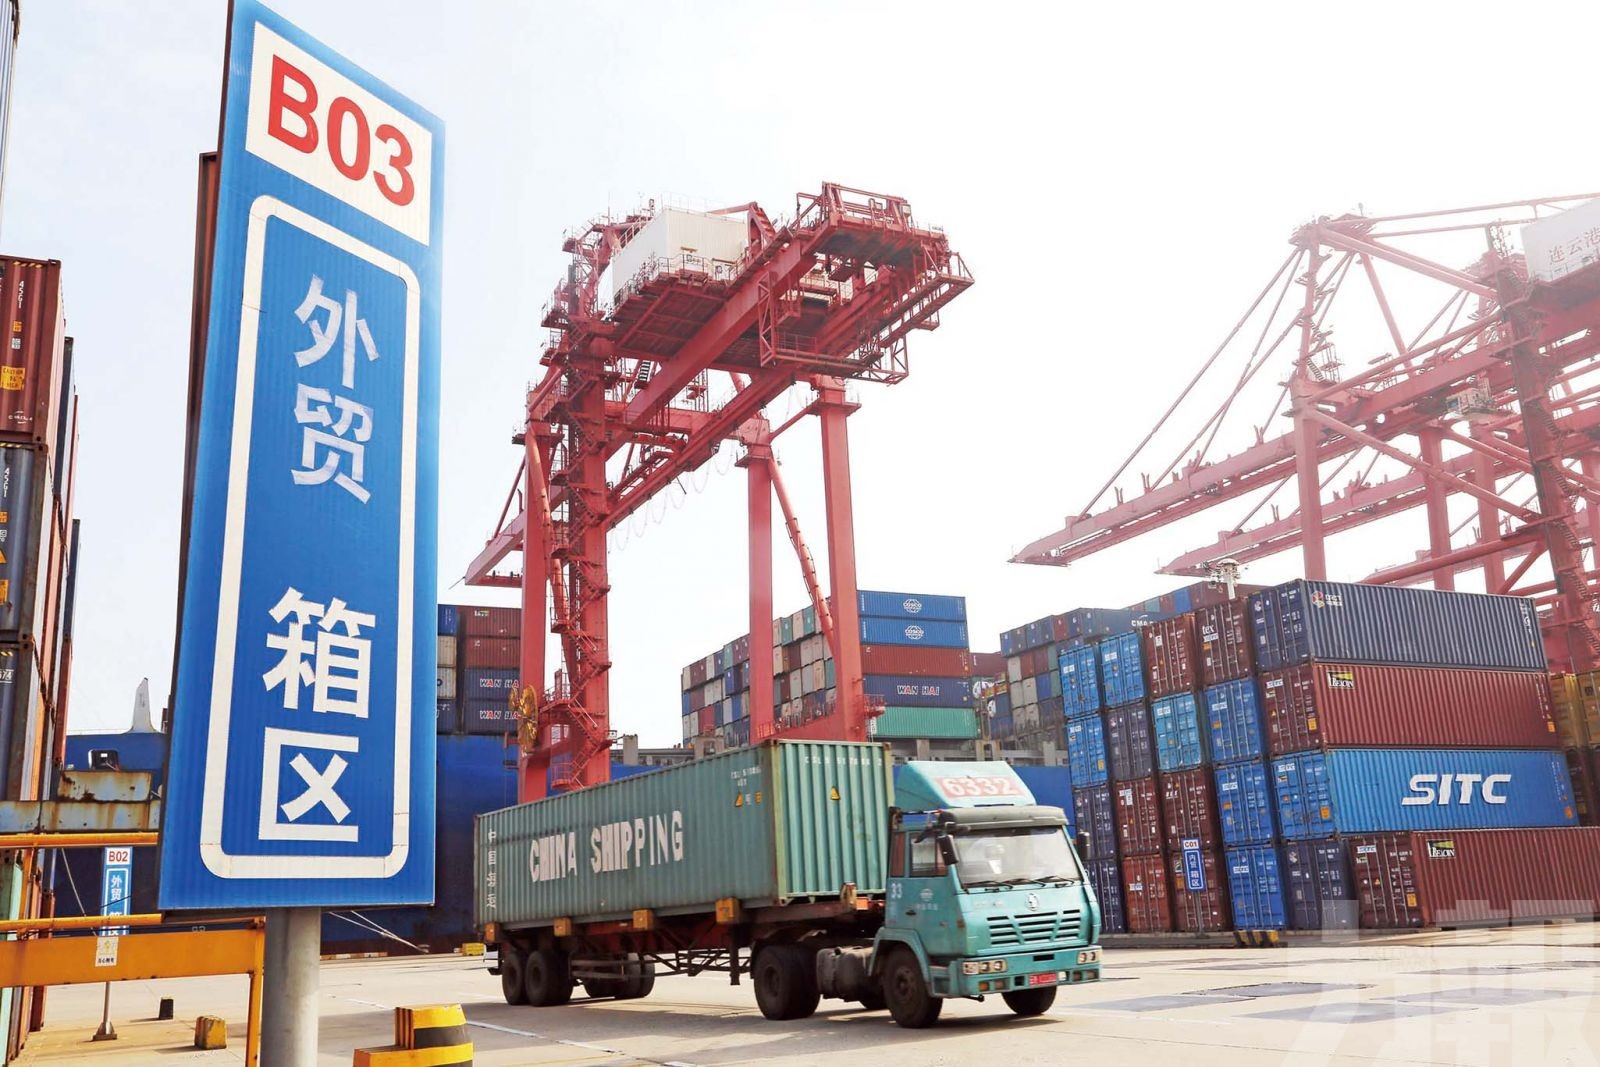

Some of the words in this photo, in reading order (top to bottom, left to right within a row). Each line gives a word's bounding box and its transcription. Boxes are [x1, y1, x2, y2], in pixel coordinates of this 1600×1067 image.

[267, 54, 415, 207] B03
[479, 678, 501, 688] WAN
[504, 679, 519, 688] HA
[897, 685, 918, 695] WAN
[922, 686, 940, 695] HAI
[479, 710, 501, 719] WAN
[504, 711, 519, 720] HA
[943, 779, 1018, 796] 6332
[1401, 774, 1512, 805] SITC
[529, 832, 577, 882] CHINA
[591, 810, 683, 874] SHIPPING
[109, 851, 128, 861] B02
[891, 883, 902, 899] 33
